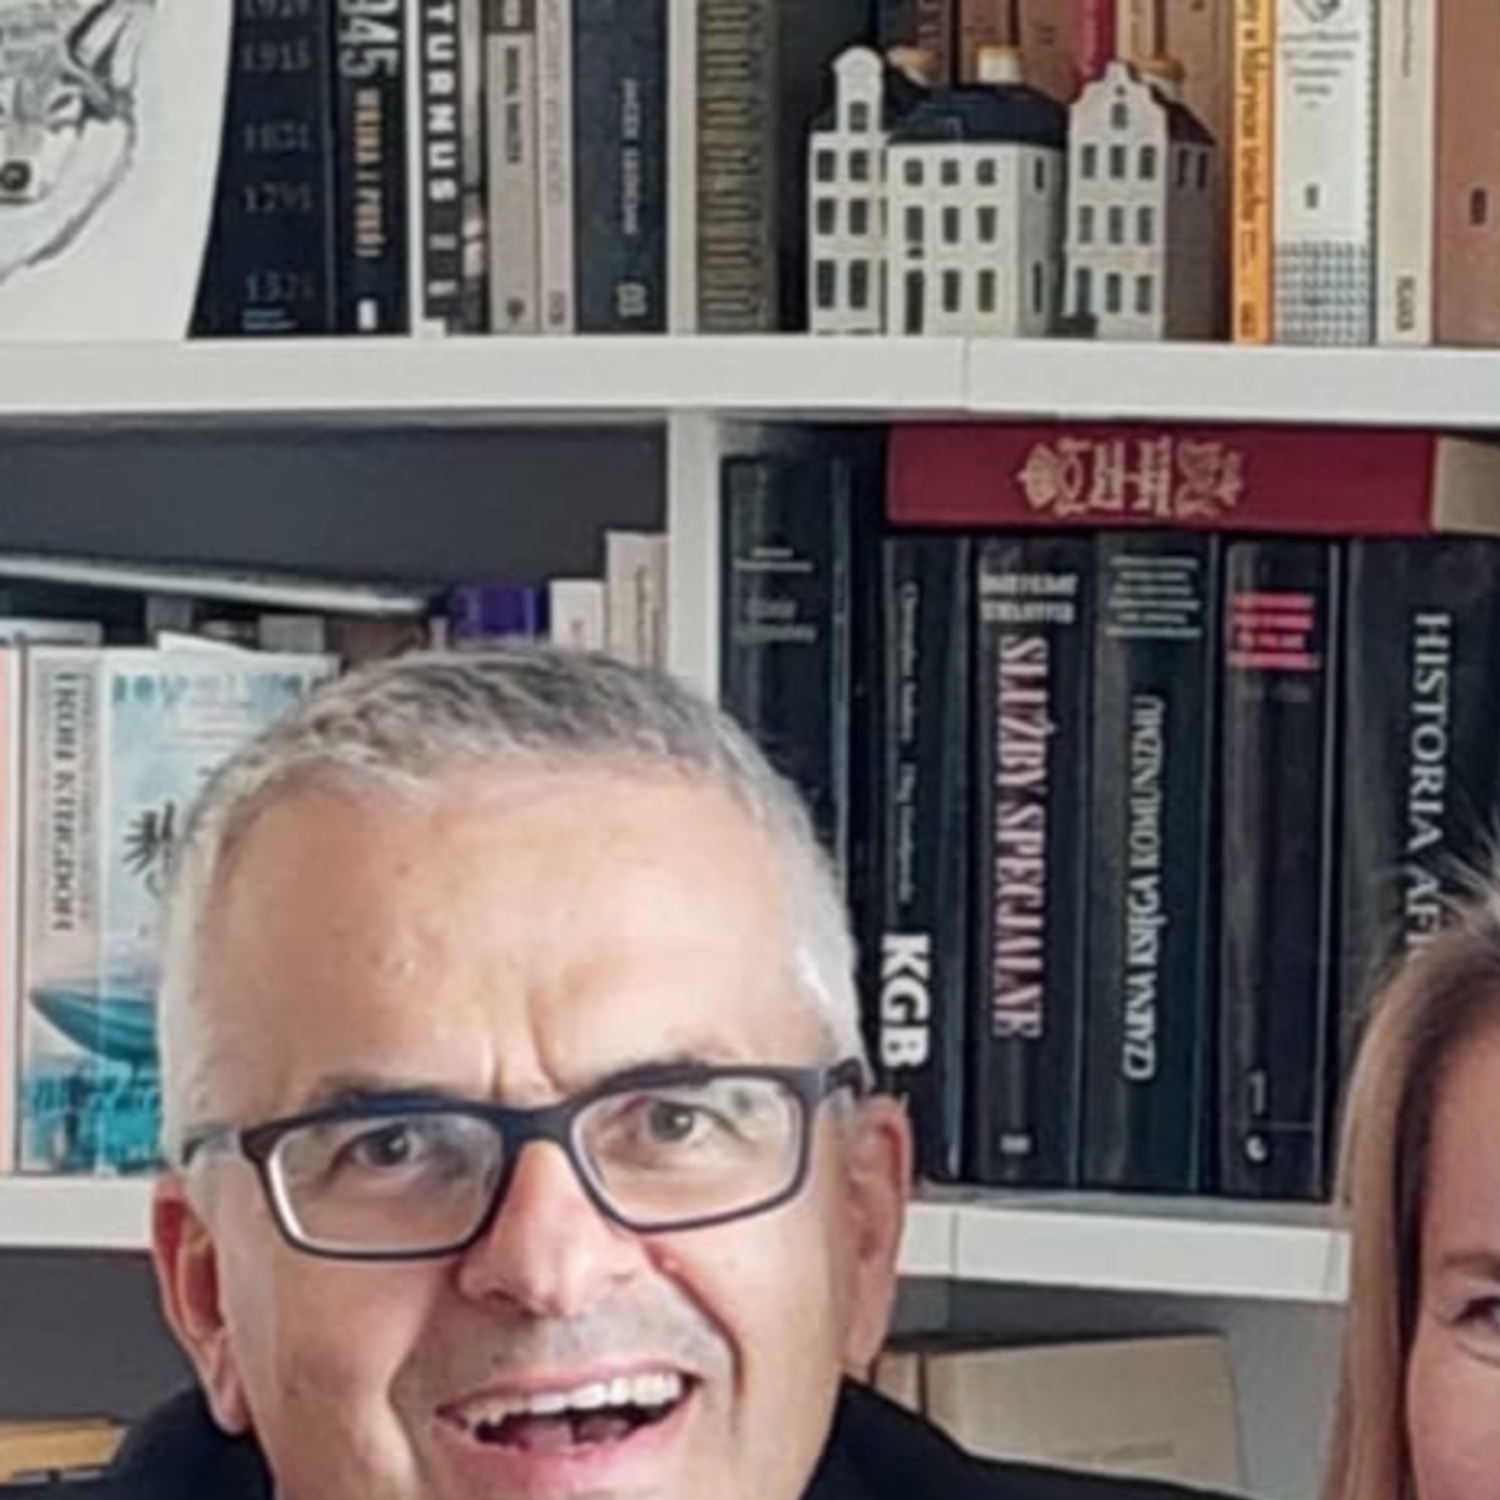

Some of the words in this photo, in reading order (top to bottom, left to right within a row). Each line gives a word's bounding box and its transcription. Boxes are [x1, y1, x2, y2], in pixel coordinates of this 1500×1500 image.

[1129, 695, 1165, 868] KOMUNIZMU
[1406, 612, 1452, 852] HISTORIA
[991, 802, 1046, 1038] SPECJALNE
[1127, 876, 1168, 966] KSIĘGA
[881, 934, 931, 1067] KGB
[1123, 972, 1157, 1081] CZARNA
